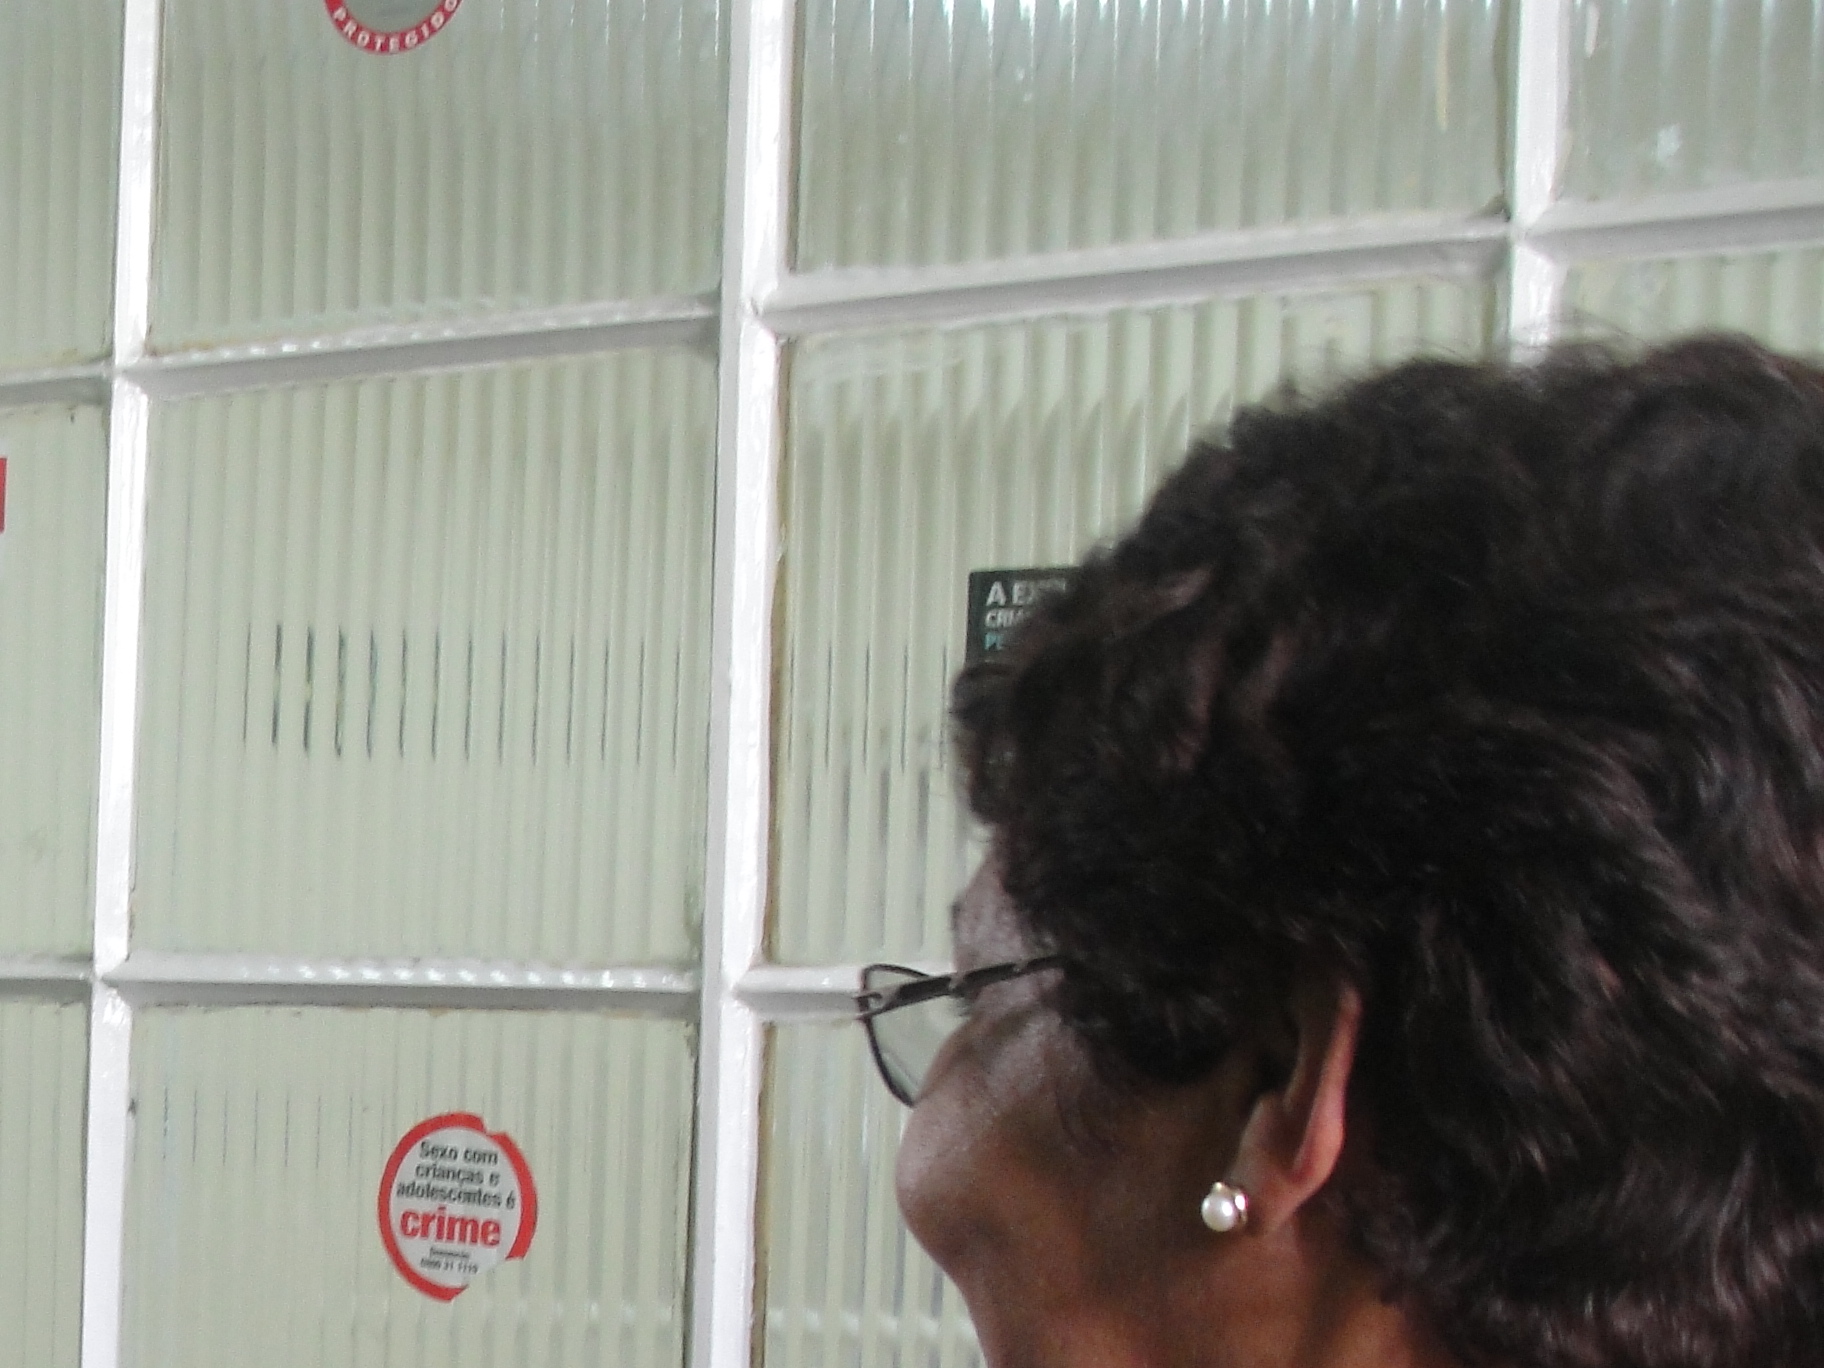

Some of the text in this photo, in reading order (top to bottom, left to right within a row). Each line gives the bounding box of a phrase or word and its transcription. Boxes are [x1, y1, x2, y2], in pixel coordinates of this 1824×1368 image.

[333, 0, 458, 53] PROTEGIDO
[986, 581, 1007, 607] A
[420, 1141, 499, 1166] Sexo com
[415, 1163, 501, 1187] crianças e
[396, 1182, 517, 1210] adolescentes é
[400, 1205, 502, 1247] crime
